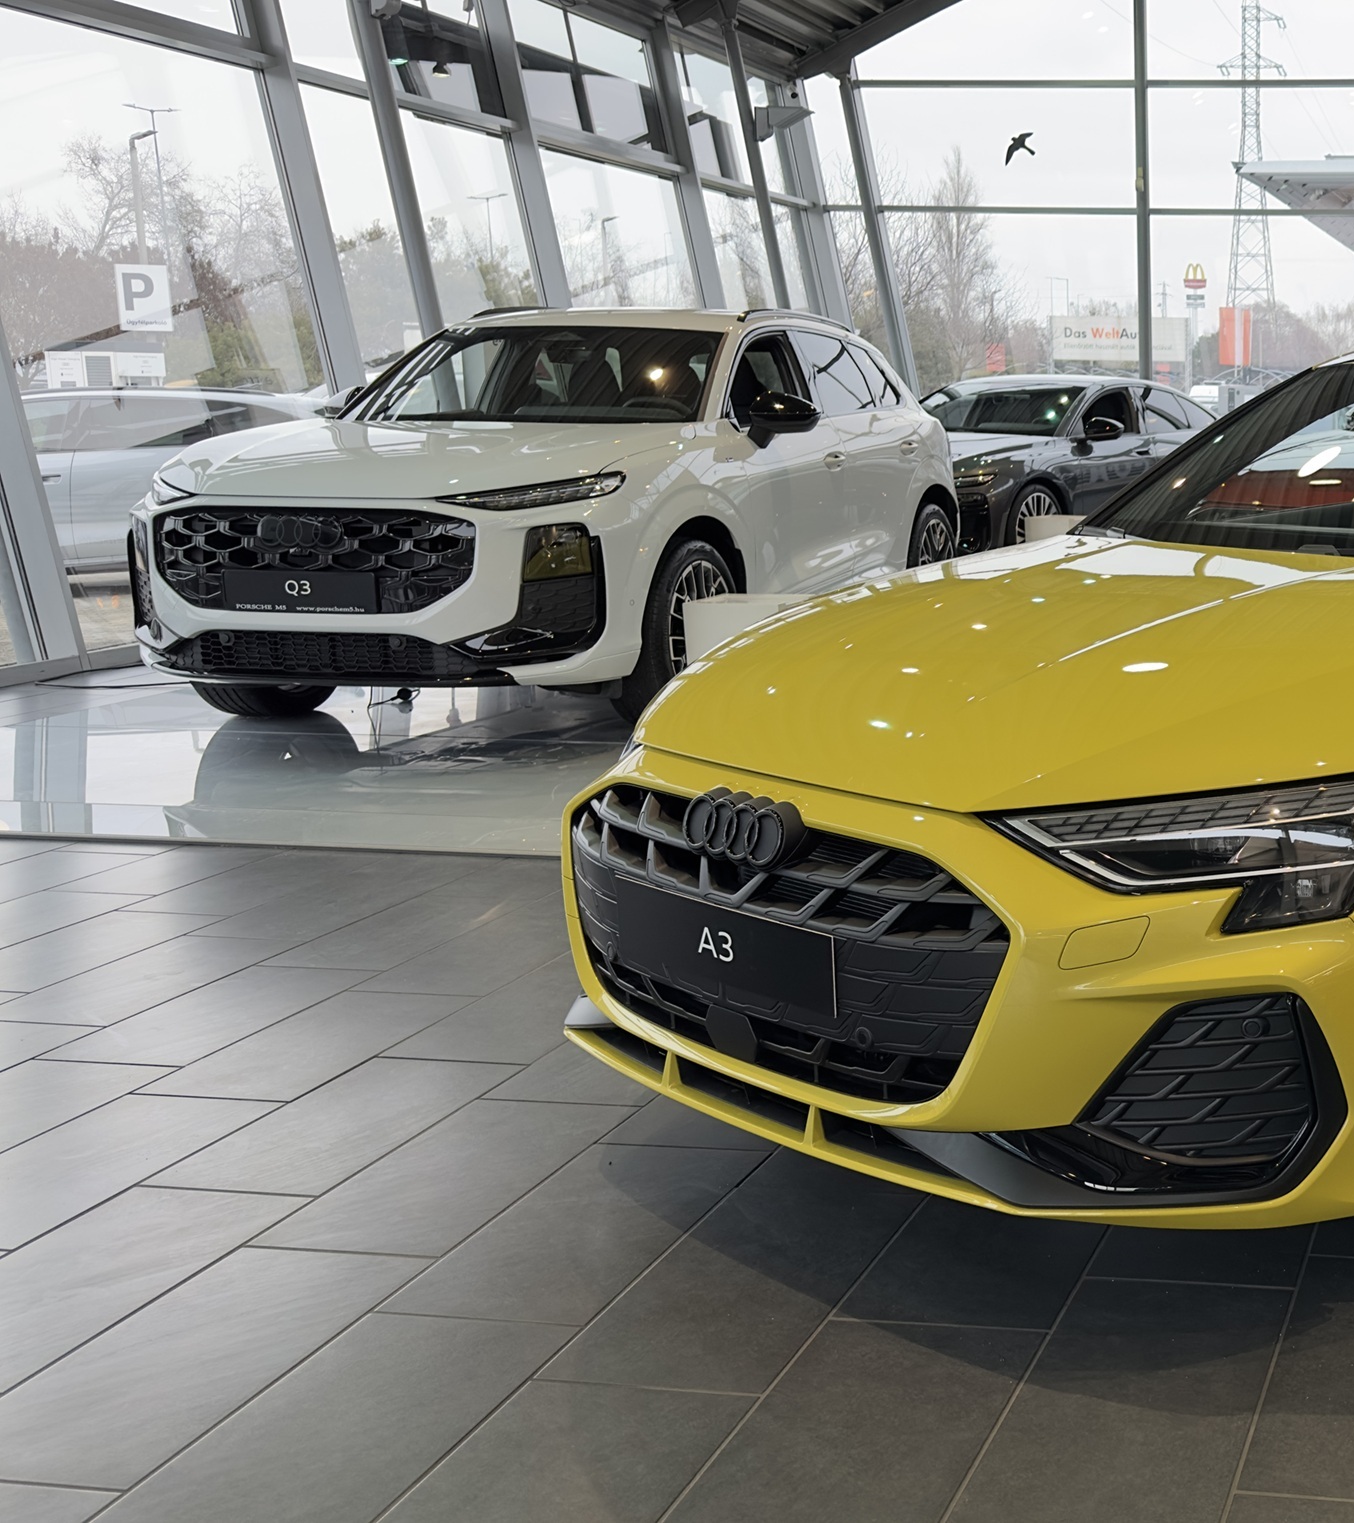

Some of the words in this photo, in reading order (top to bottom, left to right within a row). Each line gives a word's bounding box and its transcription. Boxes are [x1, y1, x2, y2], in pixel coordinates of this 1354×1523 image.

[121, 272, 154, 311] P
[1064, 327, 1087, 339] Das
[1091, 327, 1137, 340] WeltAu
[284, 579, 311, 597] Q3
[235, 603, 273, 611] PORSCHE
[697, 926, 734, 962] A3
